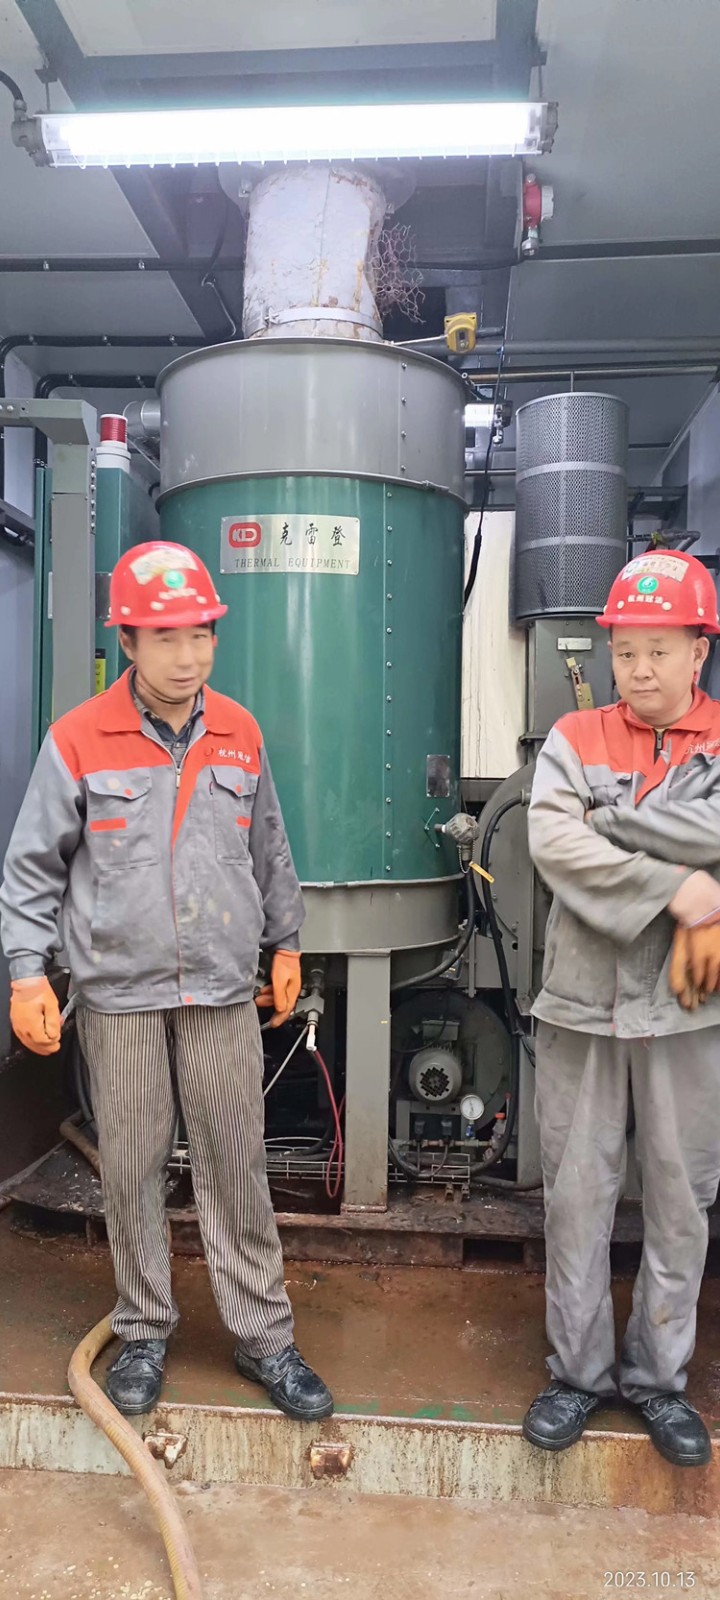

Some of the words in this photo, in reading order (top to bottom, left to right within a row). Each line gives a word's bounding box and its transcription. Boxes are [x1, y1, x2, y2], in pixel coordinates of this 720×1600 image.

[280, 522, 346, 547] 克雷登
[234, 558, 280, 568] THERMAL
[288, 558, 351, 569] EQUIPMENT
